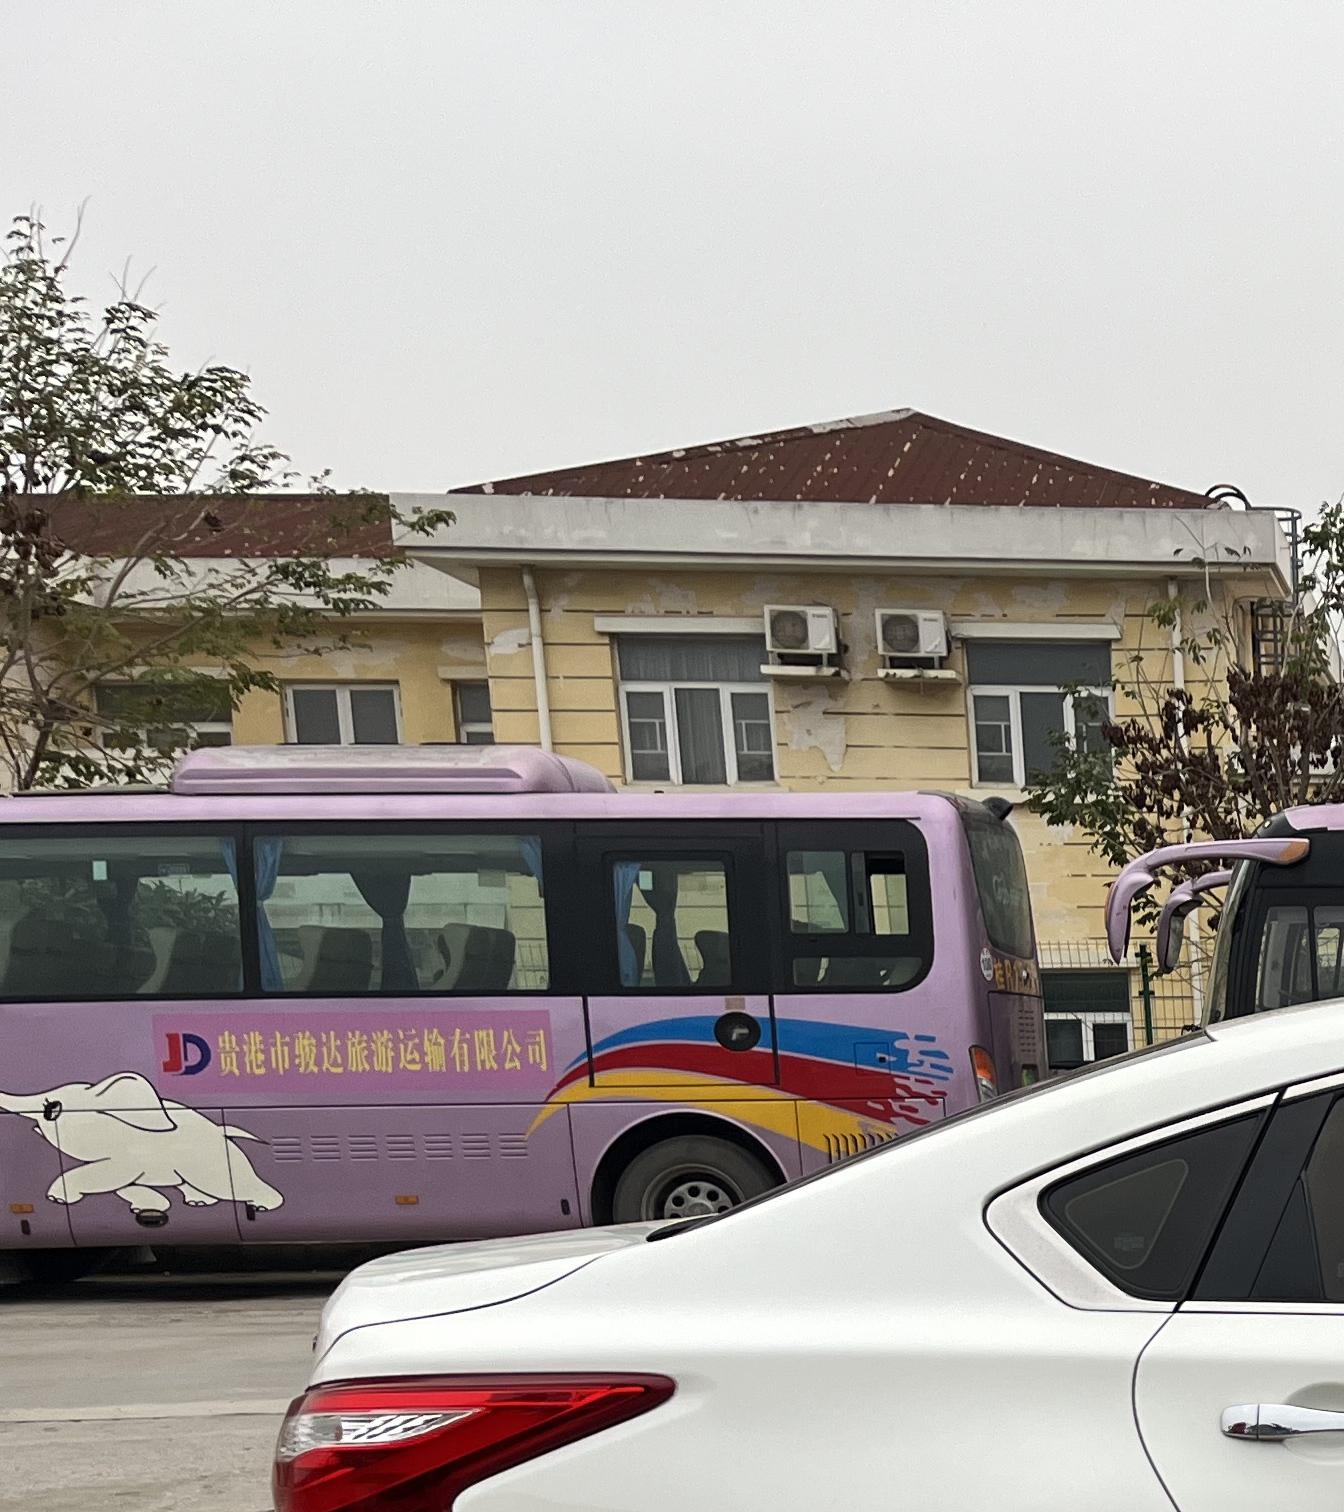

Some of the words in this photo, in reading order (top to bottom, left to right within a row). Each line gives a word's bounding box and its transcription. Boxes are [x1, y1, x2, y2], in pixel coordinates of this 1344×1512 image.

[163, 1032, 212, 1076] JD
[217, 1028, 549, 1077] 贵港市骏达旅游运输有限公司
